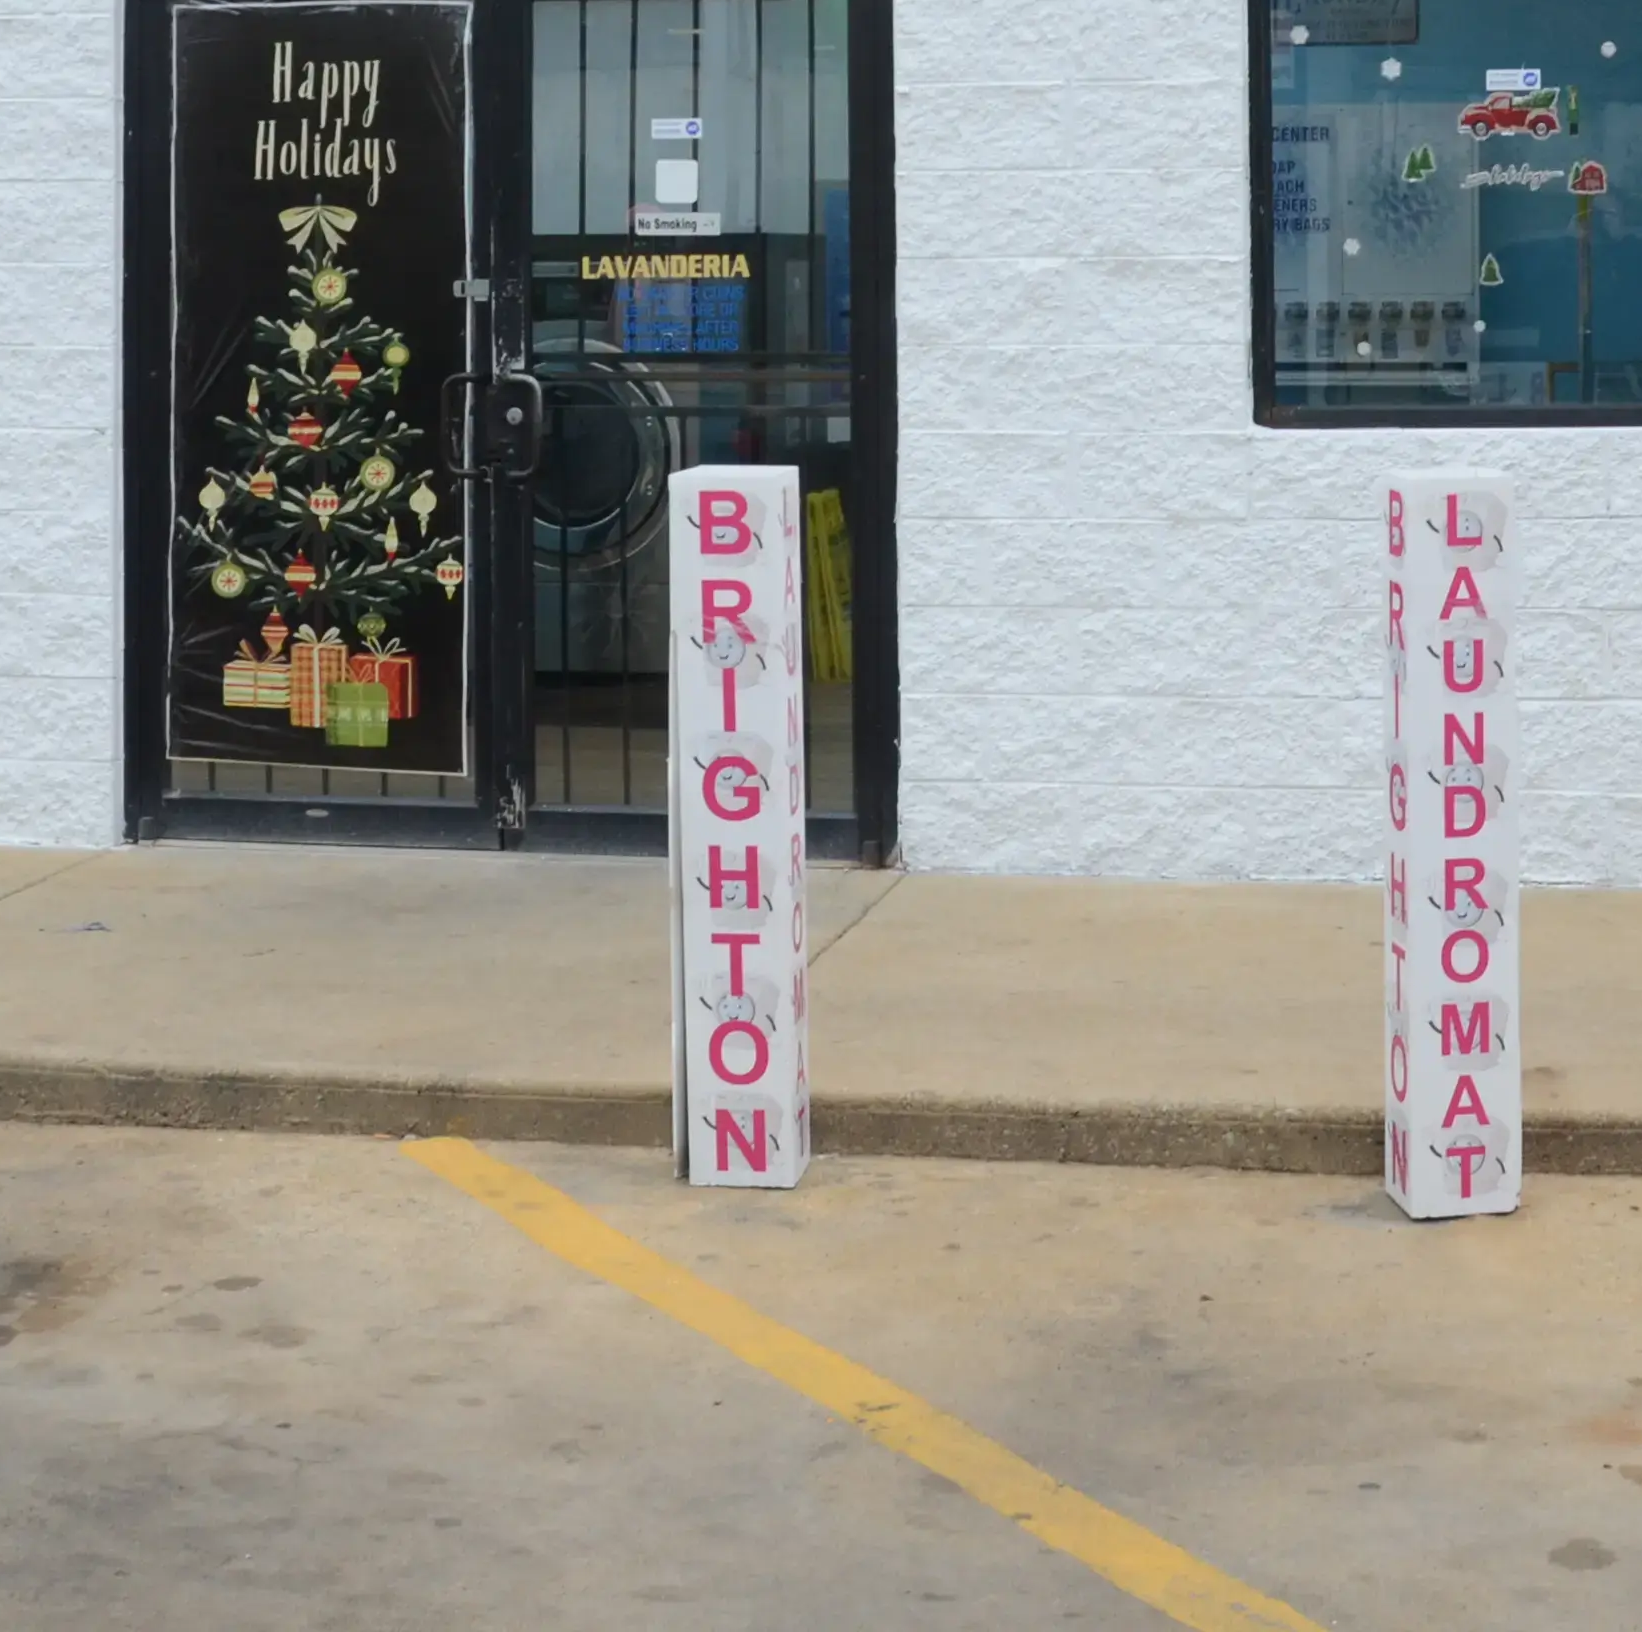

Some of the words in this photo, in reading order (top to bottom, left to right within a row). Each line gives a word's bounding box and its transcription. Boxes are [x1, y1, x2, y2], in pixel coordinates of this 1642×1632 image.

[272, 41, 380, 129] Happy
[254, 118, 397, 206] Holidays
[1272, 126, 1330, 142] CENTER
[581, 253, 750, 280] LAVANDERIA
[637, 218, 651, 230] No
[654, 218, 697, 233] Smoking
[697, 489, 770, 1173] BRIGHTON
[1388, 488, 1409, 1196] BRIGHTON
[1439, 493, 1491, 1199] LAUNDROMAT
